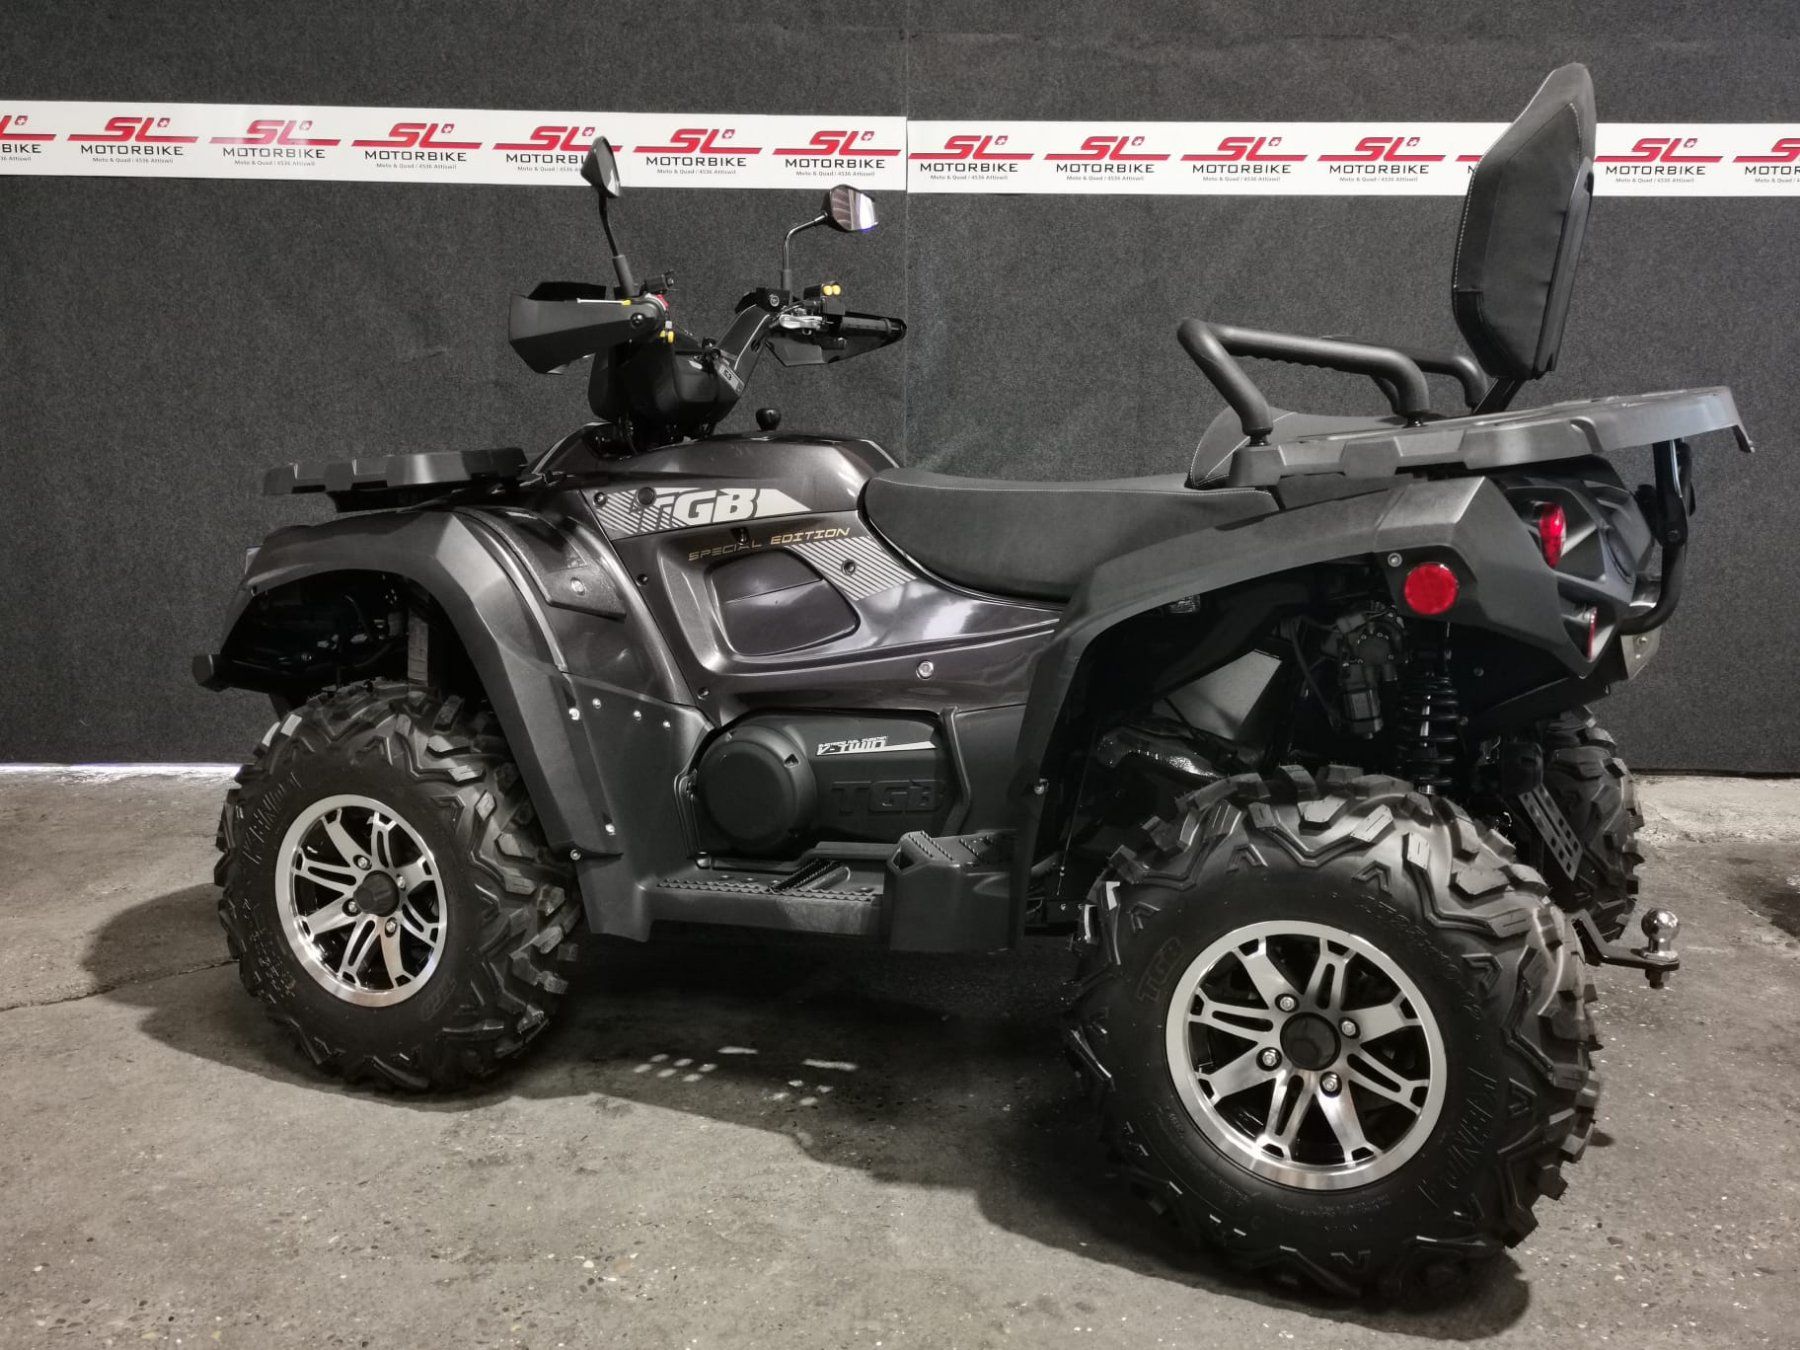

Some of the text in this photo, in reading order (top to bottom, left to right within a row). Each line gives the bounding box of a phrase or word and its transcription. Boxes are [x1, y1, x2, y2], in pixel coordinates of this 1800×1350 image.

[80, 144, 184, 156] MOTORBIKE
[222, 147, 326, 159] MOTORBIKE
[364, 150, 468, 162] MOTORBIKE
[506, 153, 585, 164] MOTORBI
[645, 156, 747, 167] MOTORBIKE
[785, 158, 885, 169] MOTORBIKE
[920, 162, 1019, 173] MOTORBIKE
[1056, 163, 1155, 173] MOTORBIKE
[1192, 164, 1292, 174] MOTORBIKE
[1329, 164, 1429, 174] MOTORBIKE
[1605, 165, 1706, 175] MOTORBIKE
[769, 527, 851, 545] EDITION
